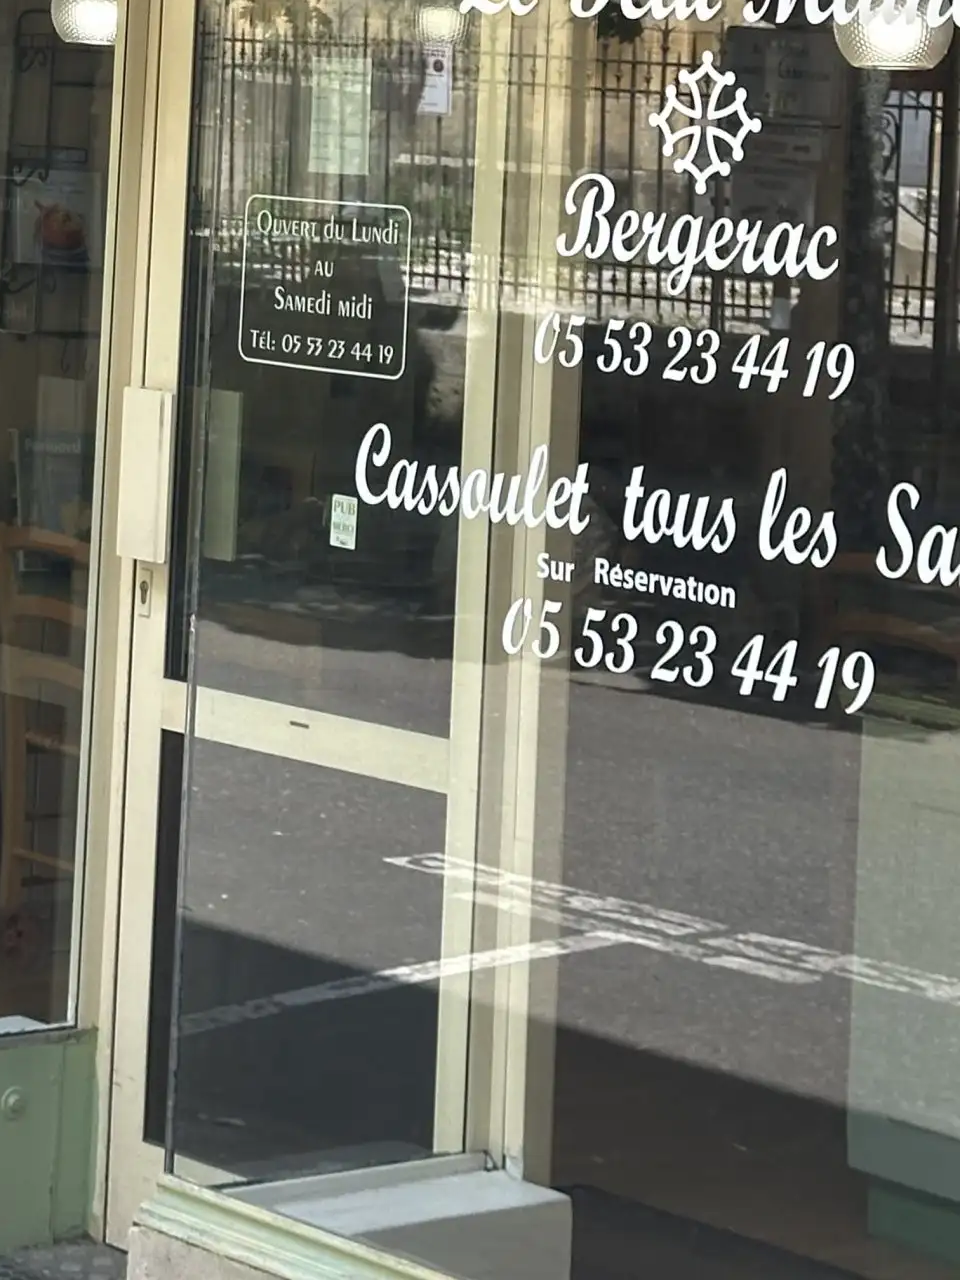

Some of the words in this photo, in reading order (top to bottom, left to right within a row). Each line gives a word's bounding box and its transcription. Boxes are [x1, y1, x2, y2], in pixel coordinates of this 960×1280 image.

[556, 173, 840, 296] Bergerac
[281, 333, 301, 354] 05
[306, 337, 323, 357] 53
[327, 339, 345, 359] 23
[350, 342, 373, 363] 44
[378, 344, 394, 365] 19
[533, 312, 586, 368] 05
[596, 320, 653, 376] 53
[662, 325, 721, 385] 23
[731, 334, 791, 393] 44
[803, 340, 855, 401] 19
[355, 423, 590, 536] Cassoulet
[623, 465, 737, 554] tous
[758, 466, 838, 568] les
[876, 482, 960, 587] Sa
[536, 553, 575, 583] Sur
[594, 557, 736, 609] Réservation
[502, 598, 562, 659] 05
[574, 608, 638, 675] 53
[650, 620, 717, 688] 23
[731, 634, 798, 702] 44
[814, 646, 875, 715] 19
